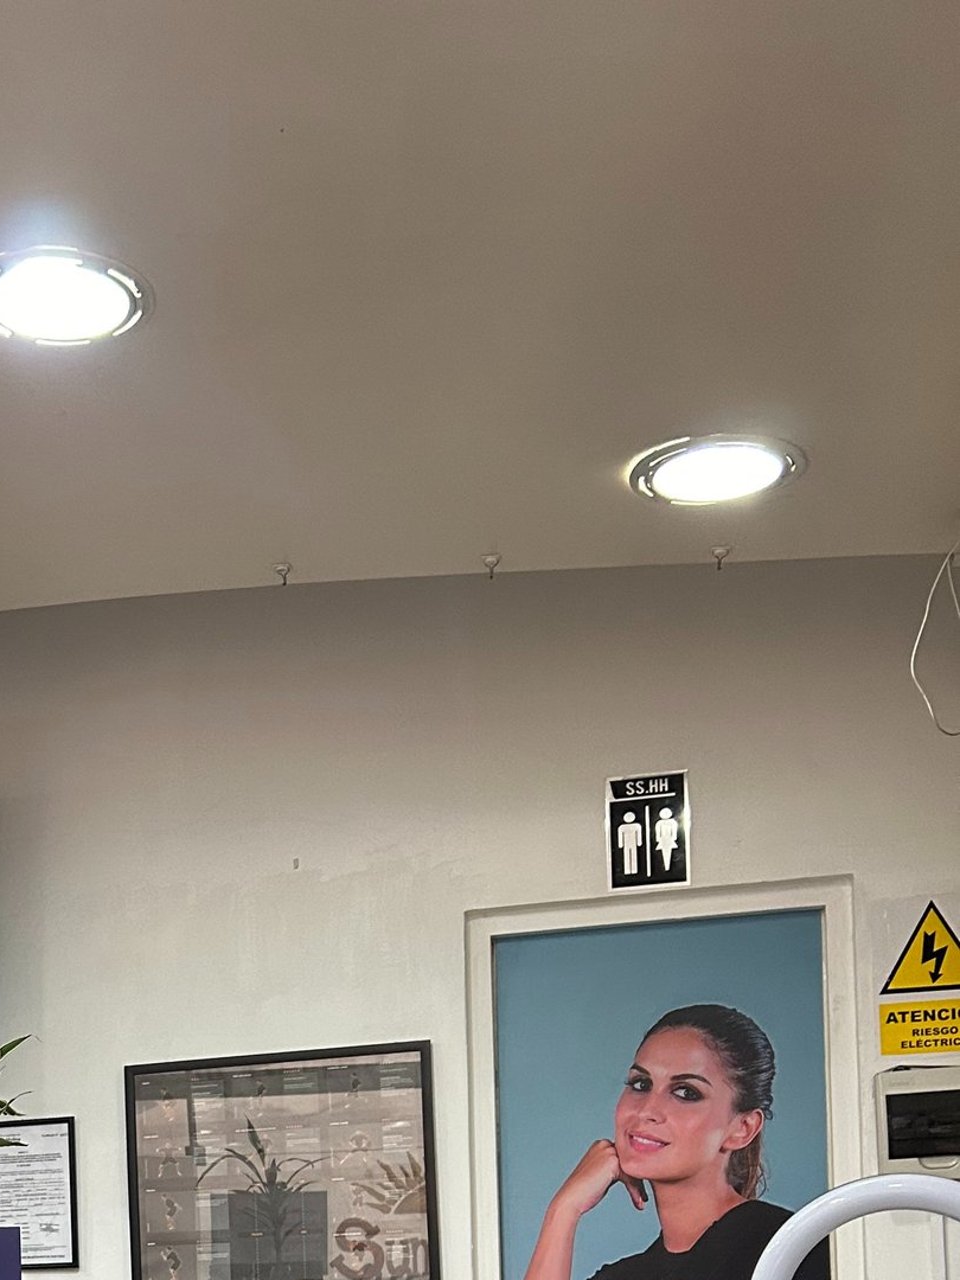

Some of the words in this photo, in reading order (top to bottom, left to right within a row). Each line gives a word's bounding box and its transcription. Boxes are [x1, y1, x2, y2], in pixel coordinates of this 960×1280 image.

[625, 778, 669, 795] SS.HH
[885, 1008, 960, 1024] ATENCI
[912, 1026, 959, 1036] RIESGO
